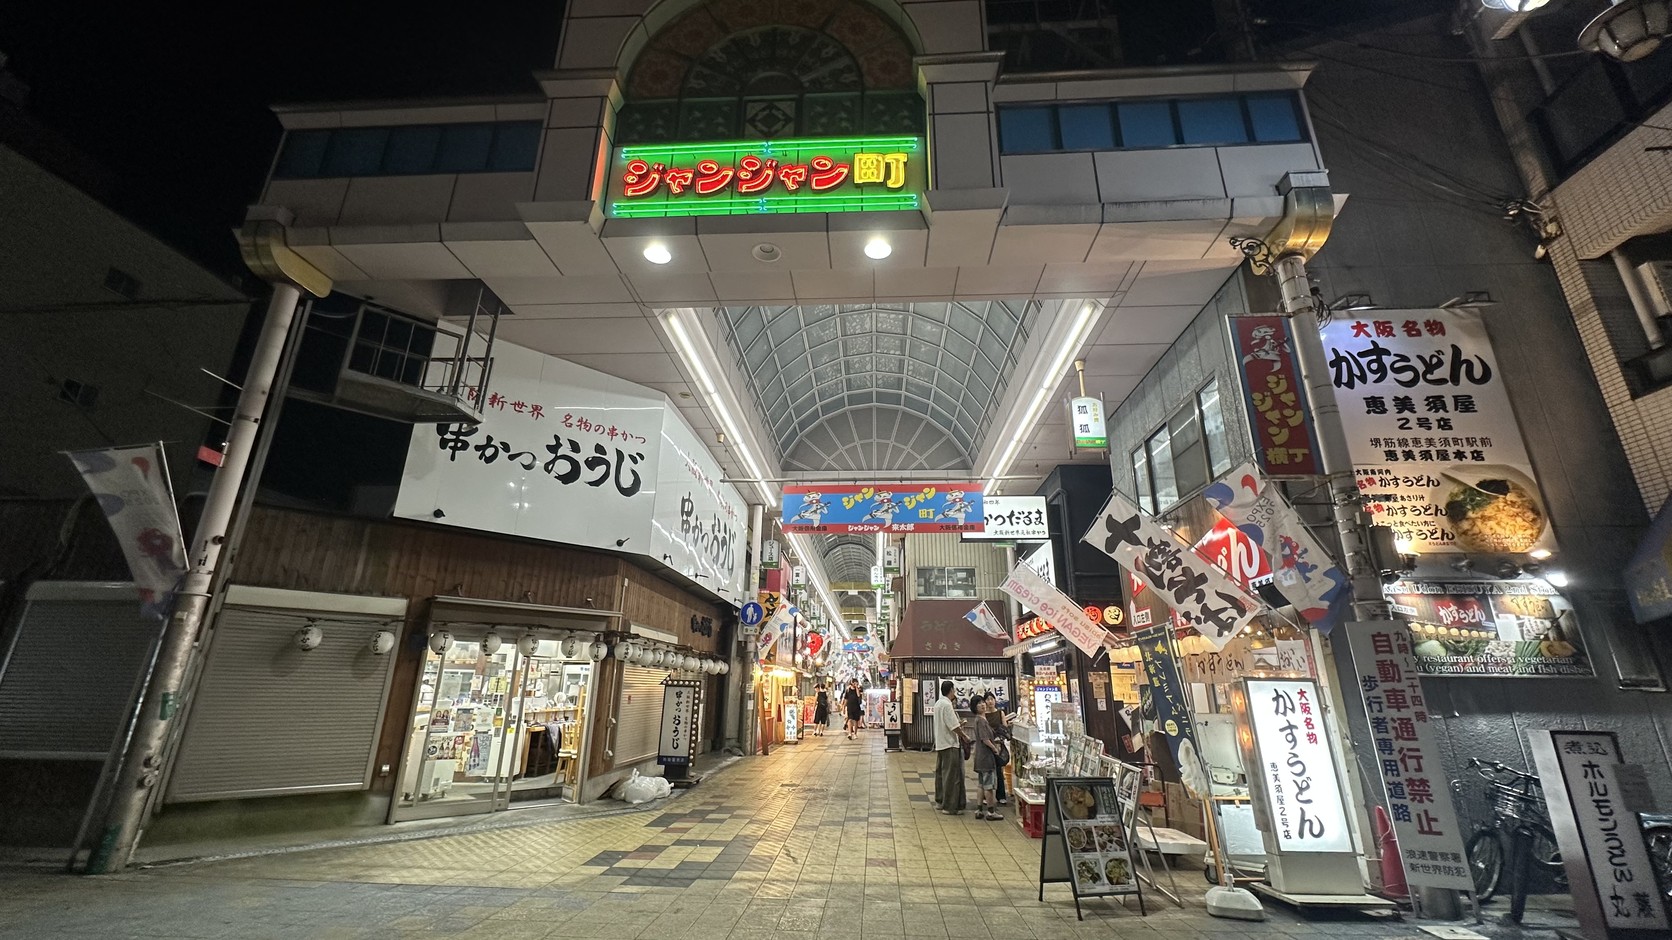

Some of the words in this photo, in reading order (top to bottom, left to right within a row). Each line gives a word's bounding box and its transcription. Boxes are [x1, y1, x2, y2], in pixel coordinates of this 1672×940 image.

[1350, 319, 1446, 339] 大阪名物
[1329, 339, 1492, 390] かすうどん
[1362, 395, 1478, 415] 恵美須屋
[560, 412, 647, 444] 名物の串かつ
[1396, 417, 1454, 431] 2号店
[1370, 437, 1493, 448] 堺筋線恵美須町駅前
[436, 423, 645, 497] 串かつおうじ
[1266, 448, 1309, 465] 横丁
[1385, 449, 1486, 462] 恵美須屋本店
[1379, 475, 1440, 488] かすうどん
[841, 487, 875, 509] ジャン
[903, 487, 936, 509] ジャン
[919, 508, 936, 519] 町
[1386, 504, 1448, 517] かすうどん
[847, 524, 880, 532] ジャンジャン
[1423, 655, 1473, 663] restaurant
[1518, 655, 1573, 665] vegetarian
[1425, 663, 1464, 674] (vegan)
[1466, 664, 1484, 673] and
[1488, 664, 1514, 673] meat
[1516, 664, 1535, 673] and
[1537, 664, 1558, 673] fish
[672, 690, 683, 750] 串かつおうじ
[1297, 688, 1318, 745] 大阪名物
[1371, 631, 1443, 837] 自動車通行禁止
[1362, 676, 1412, 823] 歩行者専用道路
[1564, 741, 1609, 756] 煮込
[1272, 688, 1325, 840] かすうどん
[1270, 762, 1292, 840] 恵美須屋2号店
[1581, 760, 1633, 883] ホルモンうどん
[1409, 863, 1467, 878] 新世界防犯
